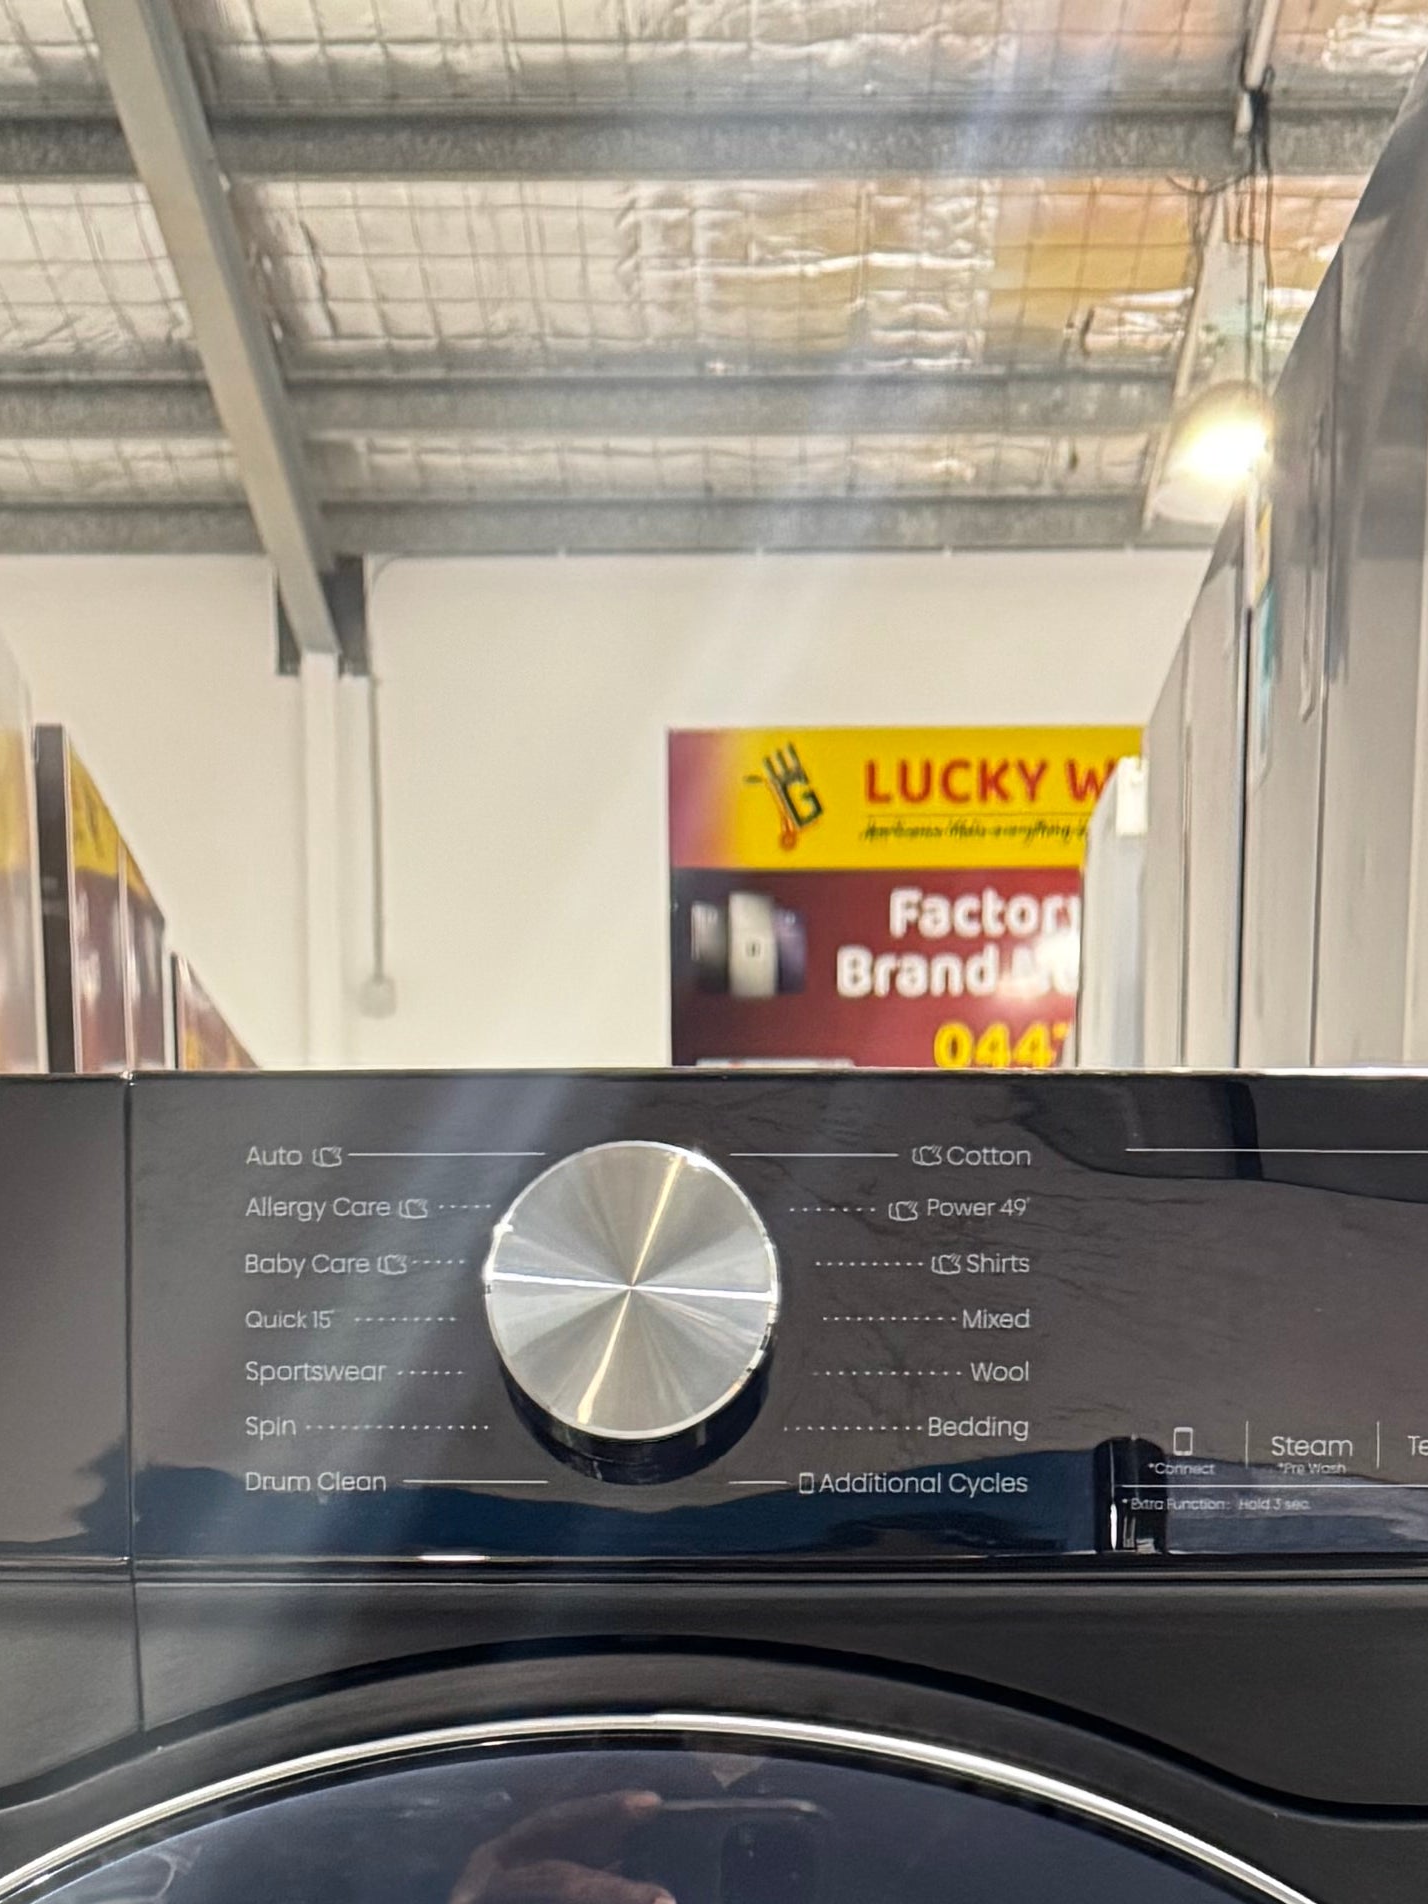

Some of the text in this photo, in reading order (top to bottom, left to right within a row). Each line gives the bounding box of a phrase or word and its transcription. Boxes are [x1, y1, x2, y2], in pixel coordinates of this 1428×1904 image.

[865, 757, 1048, 804] LUCKY
[836, 942, 1001, 998] Brand
[245, 1145, 303, 1166] Auto
[946, 1145, 1032, 1167] Cotton
[245, 1195, 391, 1222] Allergy Care
[927, 1198, 996, 1217] Power
[244, 1252, 371, 1279] Baby Care
[966, 1252, 1031, 1274] Shirts
[245, 1310, 308, 1329] Quick
[961, 1308, 1031, 1330] Mixed
[245, 1360, 388, 1386] Sportswear
[970, 1360, 1030, 1382] Wool
[245, 1415, 297, 1441] Spin
[927, 1416, 1029, 1442] Bedding
[1271, 1435, 1354, 1457] Steam
[1308, 1463, 1347, 1475] Wash
[245, 1471, 387, 1492] Drum Clean
[818, 1472, 1029, 1499] Additional Cycles
[1237, 1499, 1271, 1511] Hold
